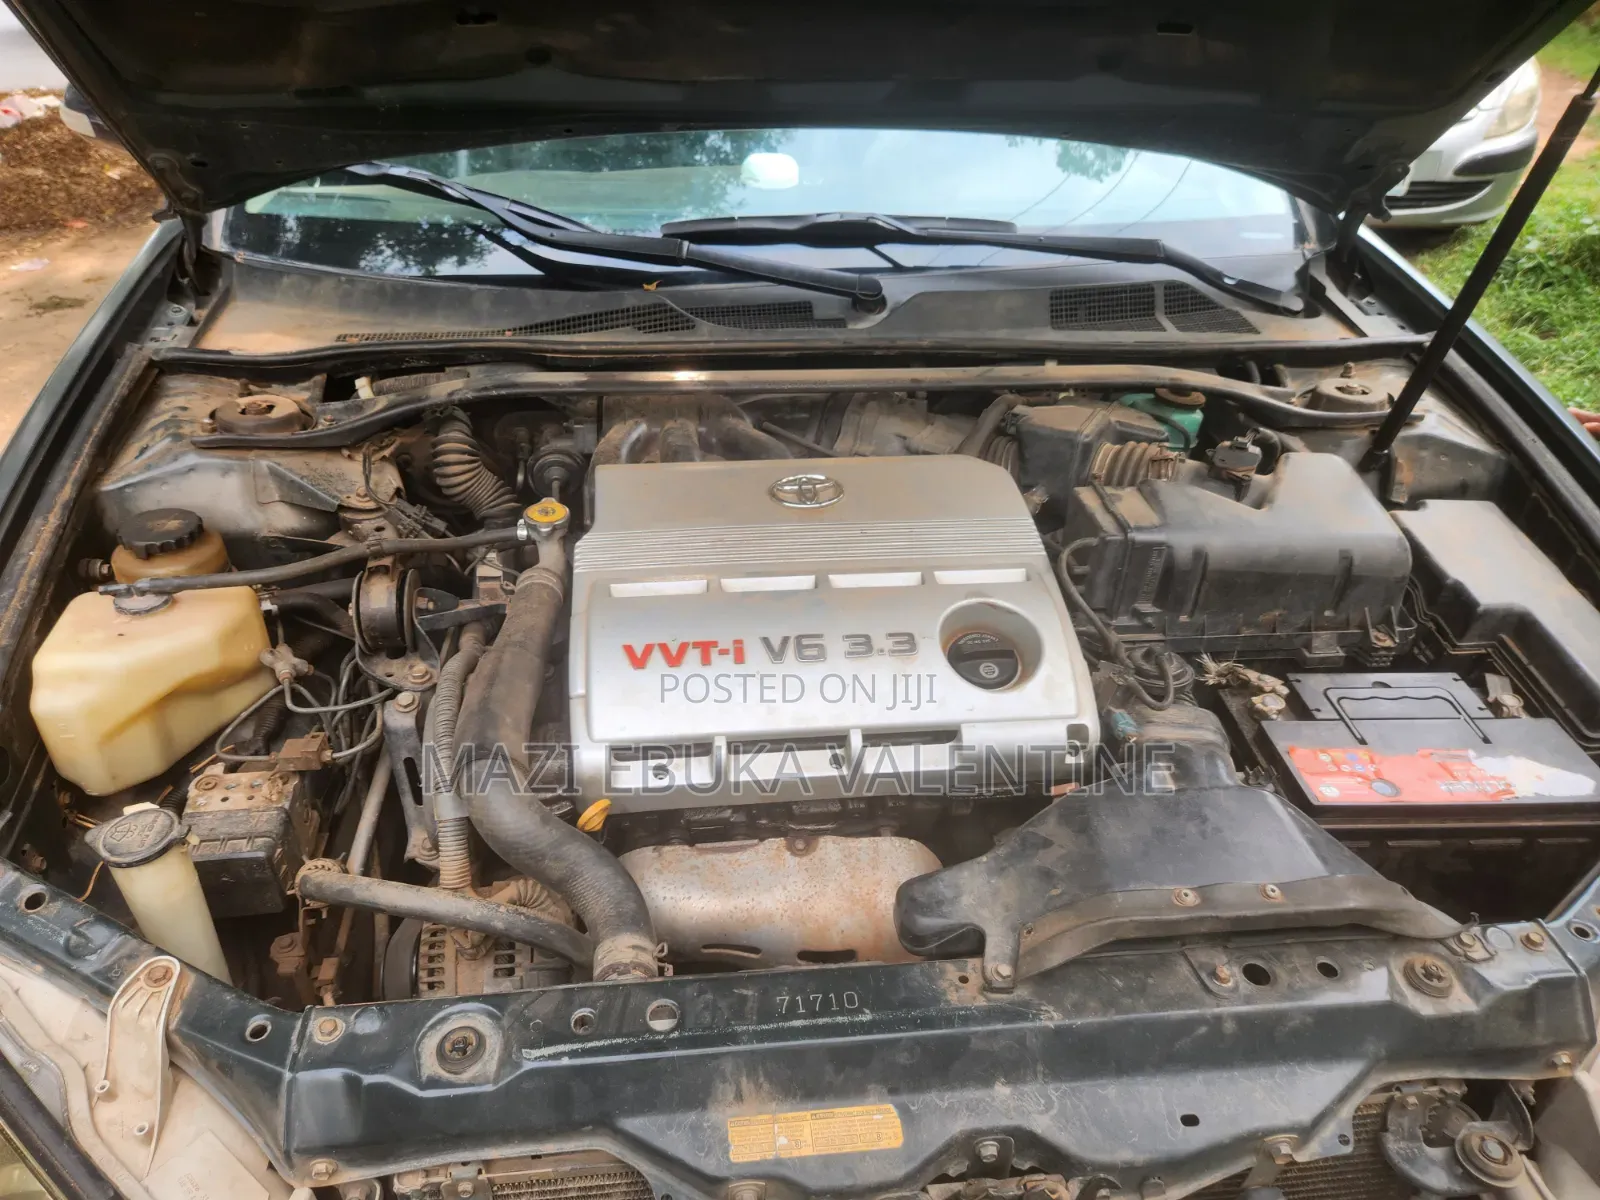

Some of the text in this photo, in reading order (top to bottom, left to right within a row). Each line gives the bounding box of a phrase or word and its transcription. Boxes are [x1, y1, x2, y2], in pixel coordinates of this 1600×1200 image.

[621, 632, 918, 670] VVT-i V6 3.3
[776, 991, 859, 1014] 71710
